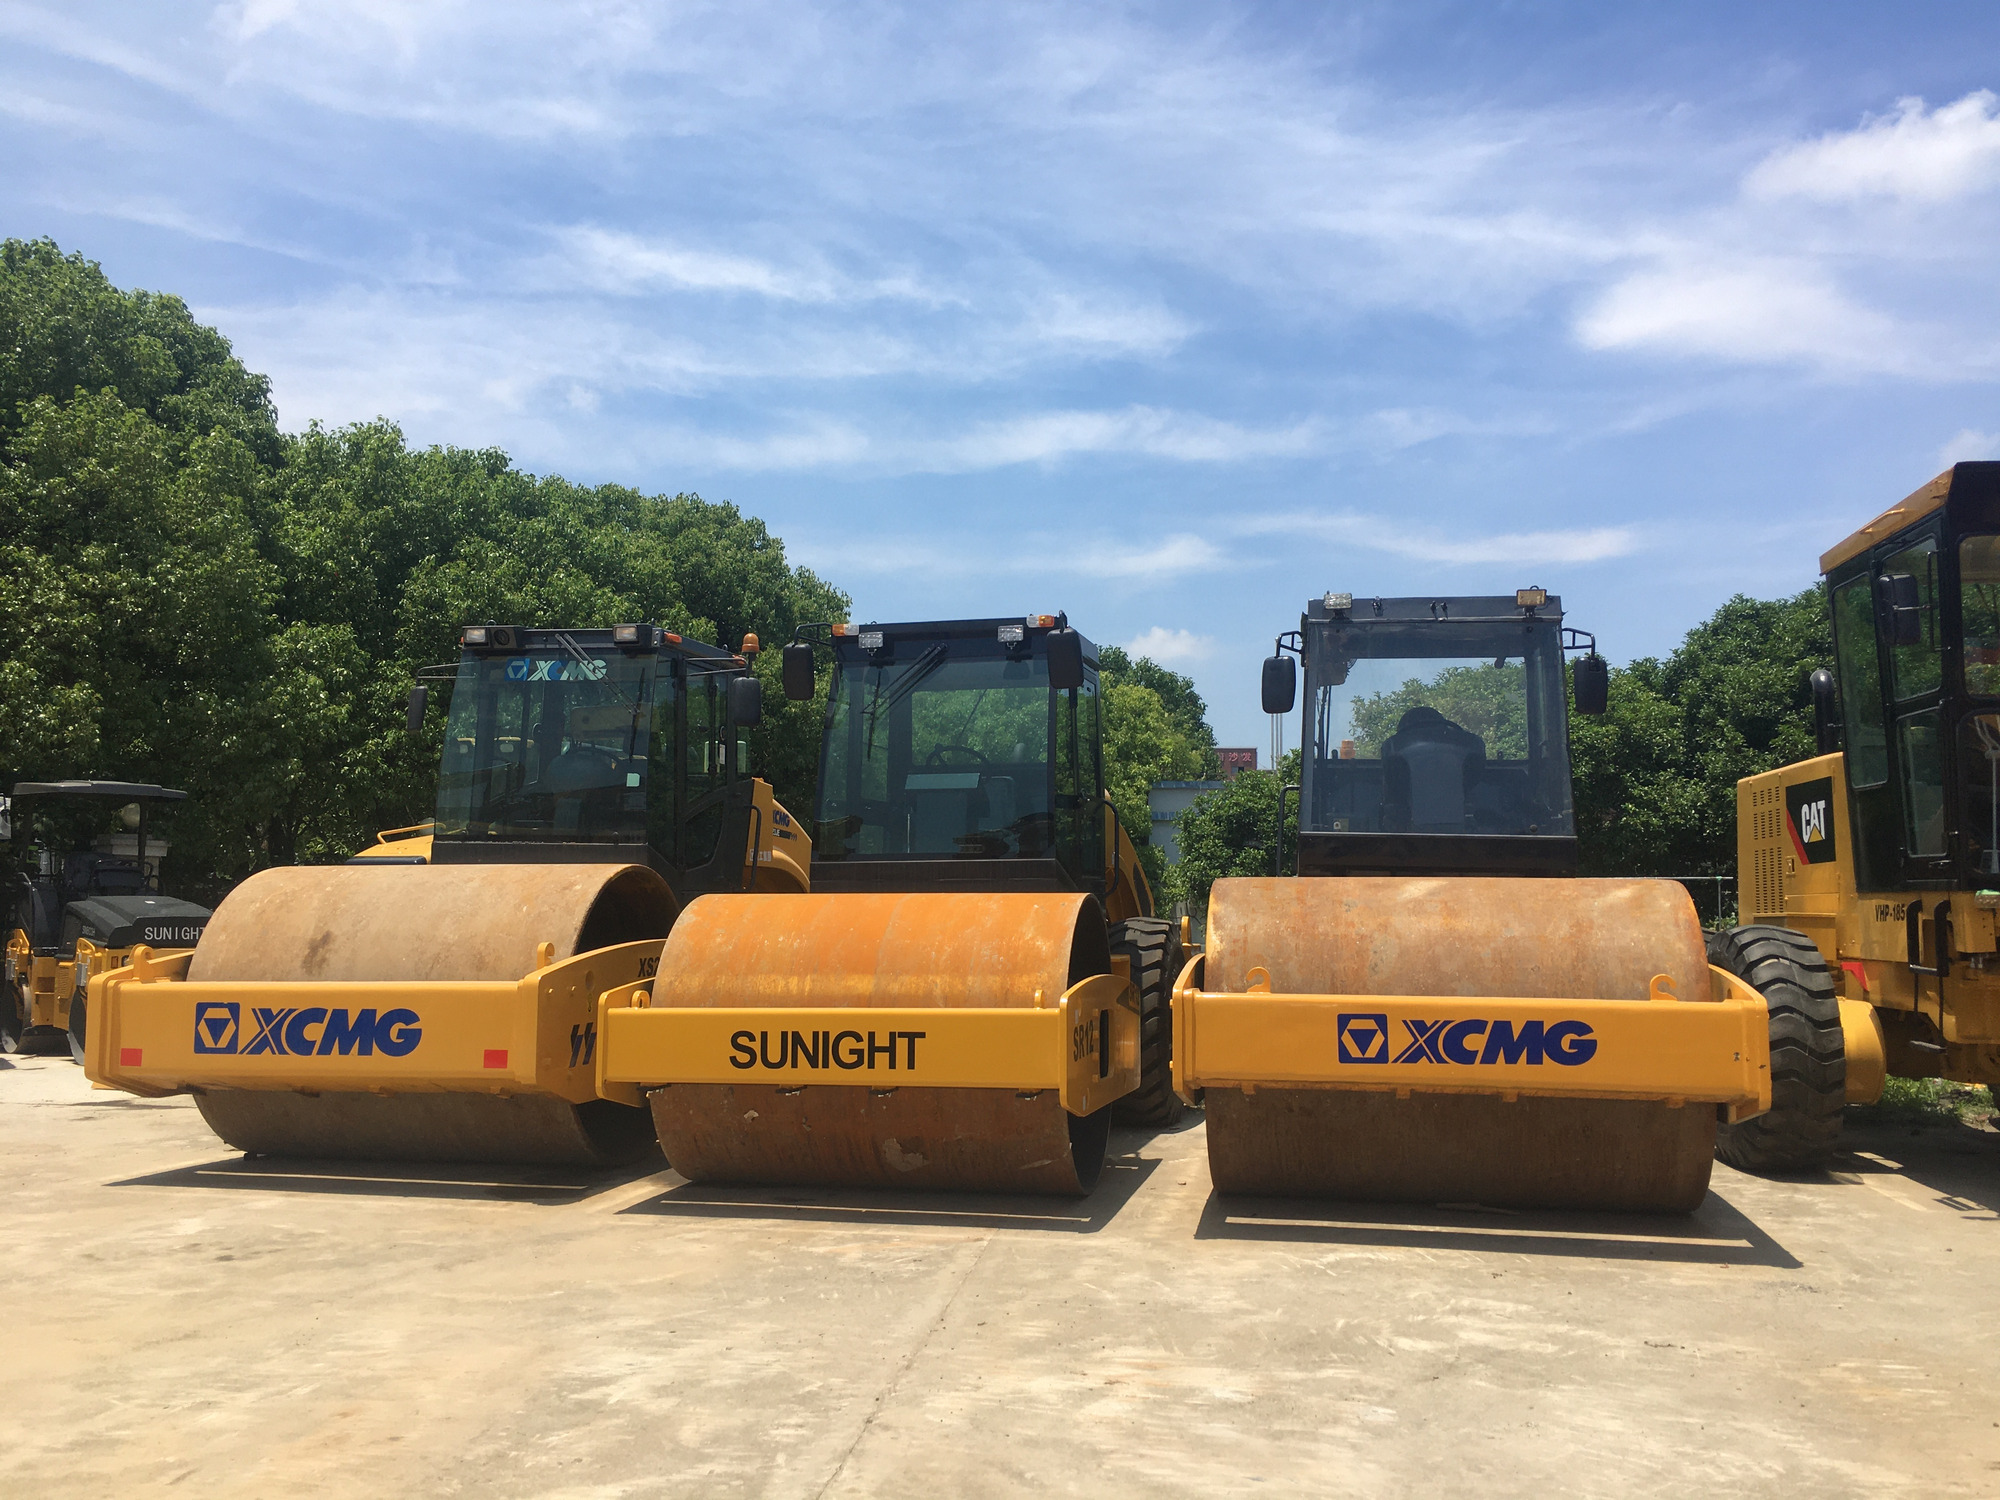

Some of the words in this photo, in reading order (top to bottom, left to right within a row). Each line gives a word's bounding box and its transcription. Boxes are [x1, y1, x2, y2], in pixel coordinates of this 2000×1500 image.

[527, 659, 607, 681] XCMG
[1217, 752, 1252, 762] 沙发
[1801, 800, 1826, 843] CAT
[1875, 903, 1907, 922] VHP-185
[238, 1007, 423, 1057] XCMG
[729, 1030, 926, 1070] SUNIGHT
[1390, 1019, 1598, 1066] XCMG
